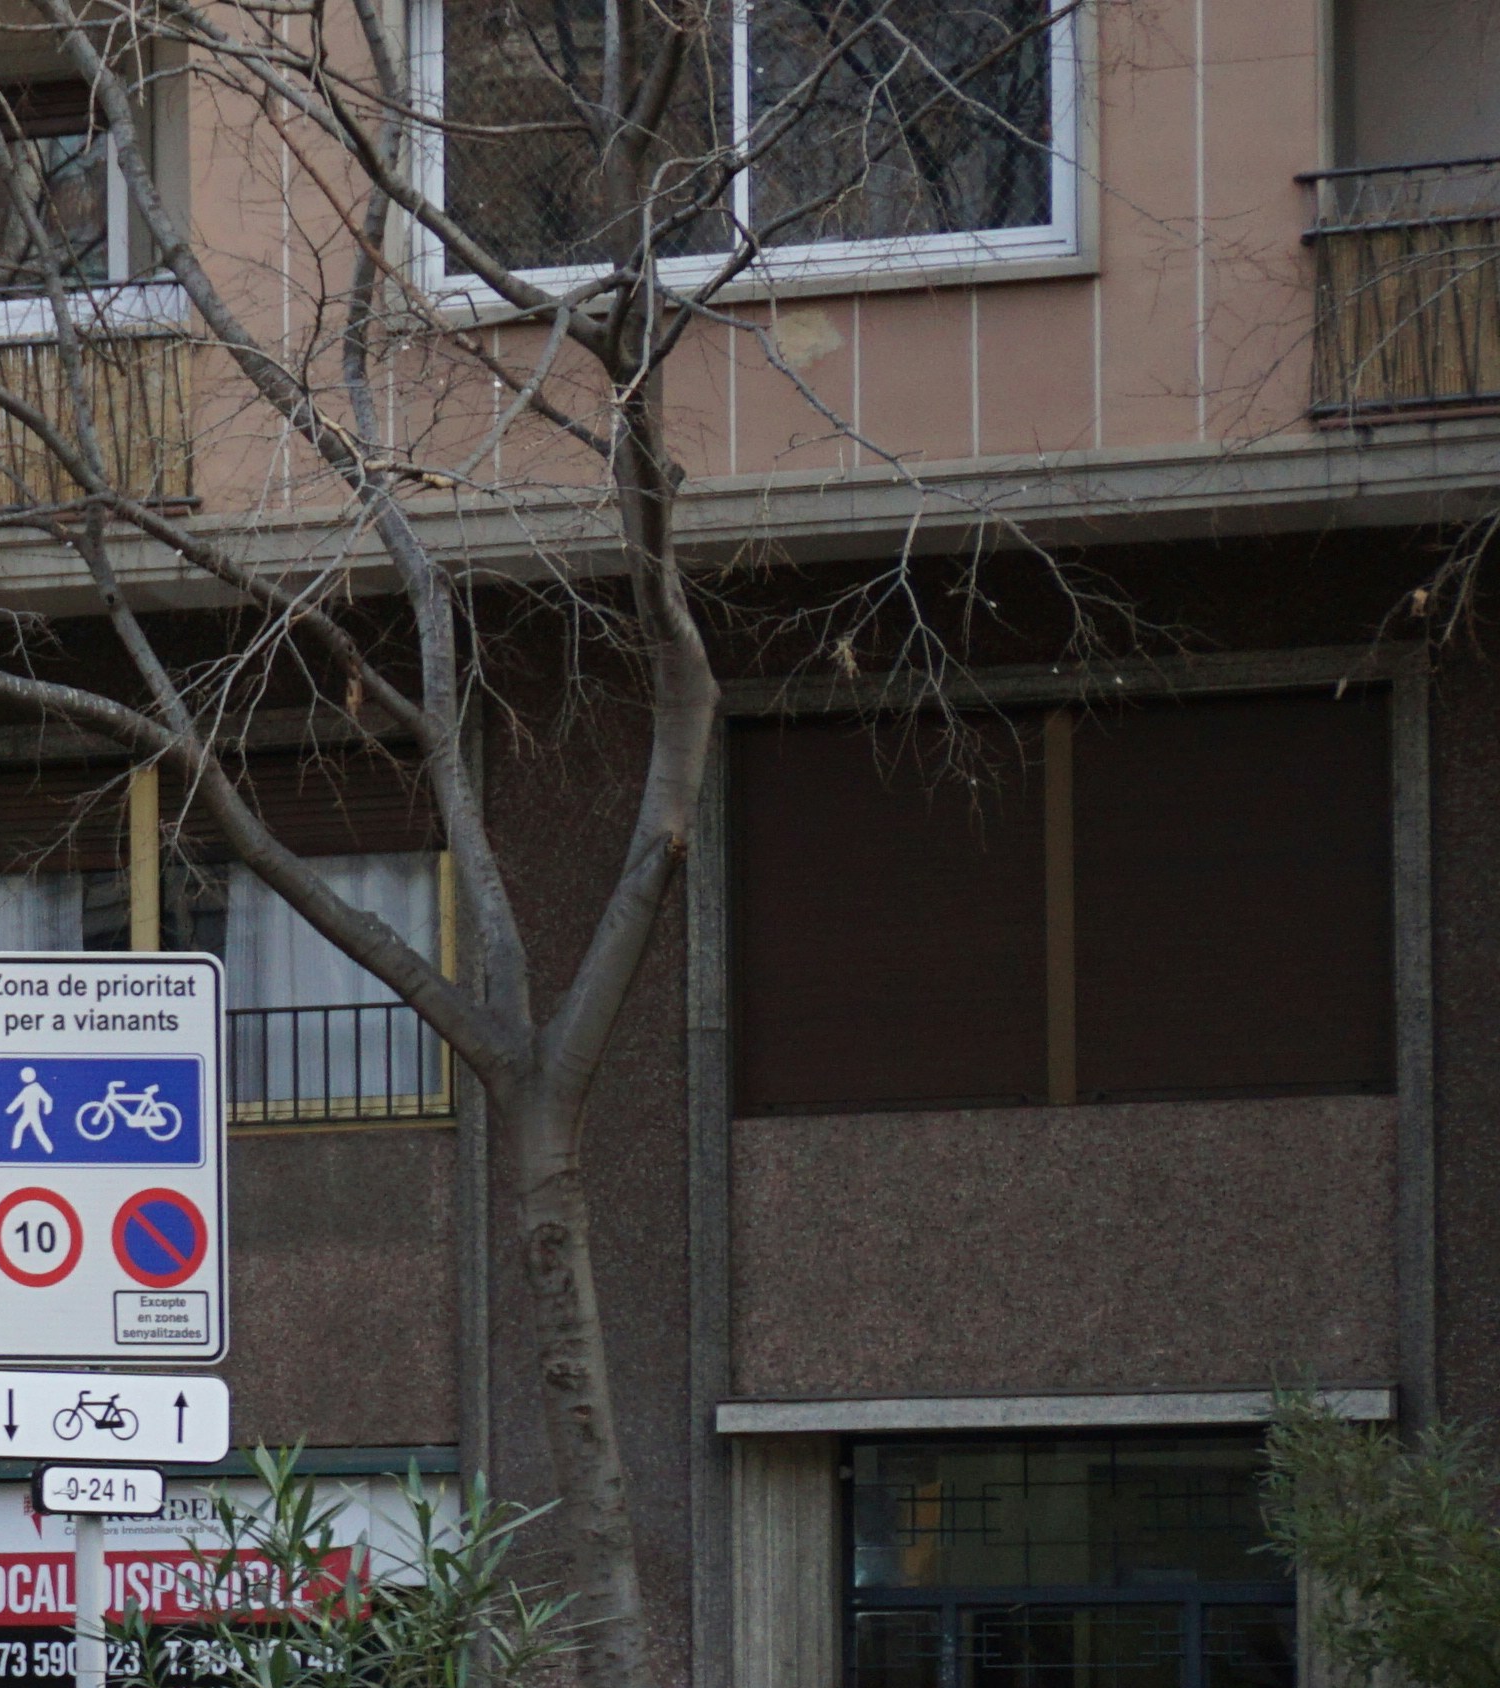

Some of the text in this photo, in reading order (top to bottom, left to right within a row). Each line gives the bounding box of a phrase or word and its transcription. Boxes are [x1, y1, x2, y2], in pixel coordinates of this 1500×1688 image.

[58, 974, 88, 997] de
[96, 974, 197, 1002] prioritat
[4, 1008, 180, 1036] per a vianants
[14, 1221, 57, 1254] 10
[140, 1296, 187, 1309] Excepte
[138, 1313, 189, 1323] en zones
[122, 1326, 203, 1340] senyalitzades
[124, 1478, 137, 1502] h
